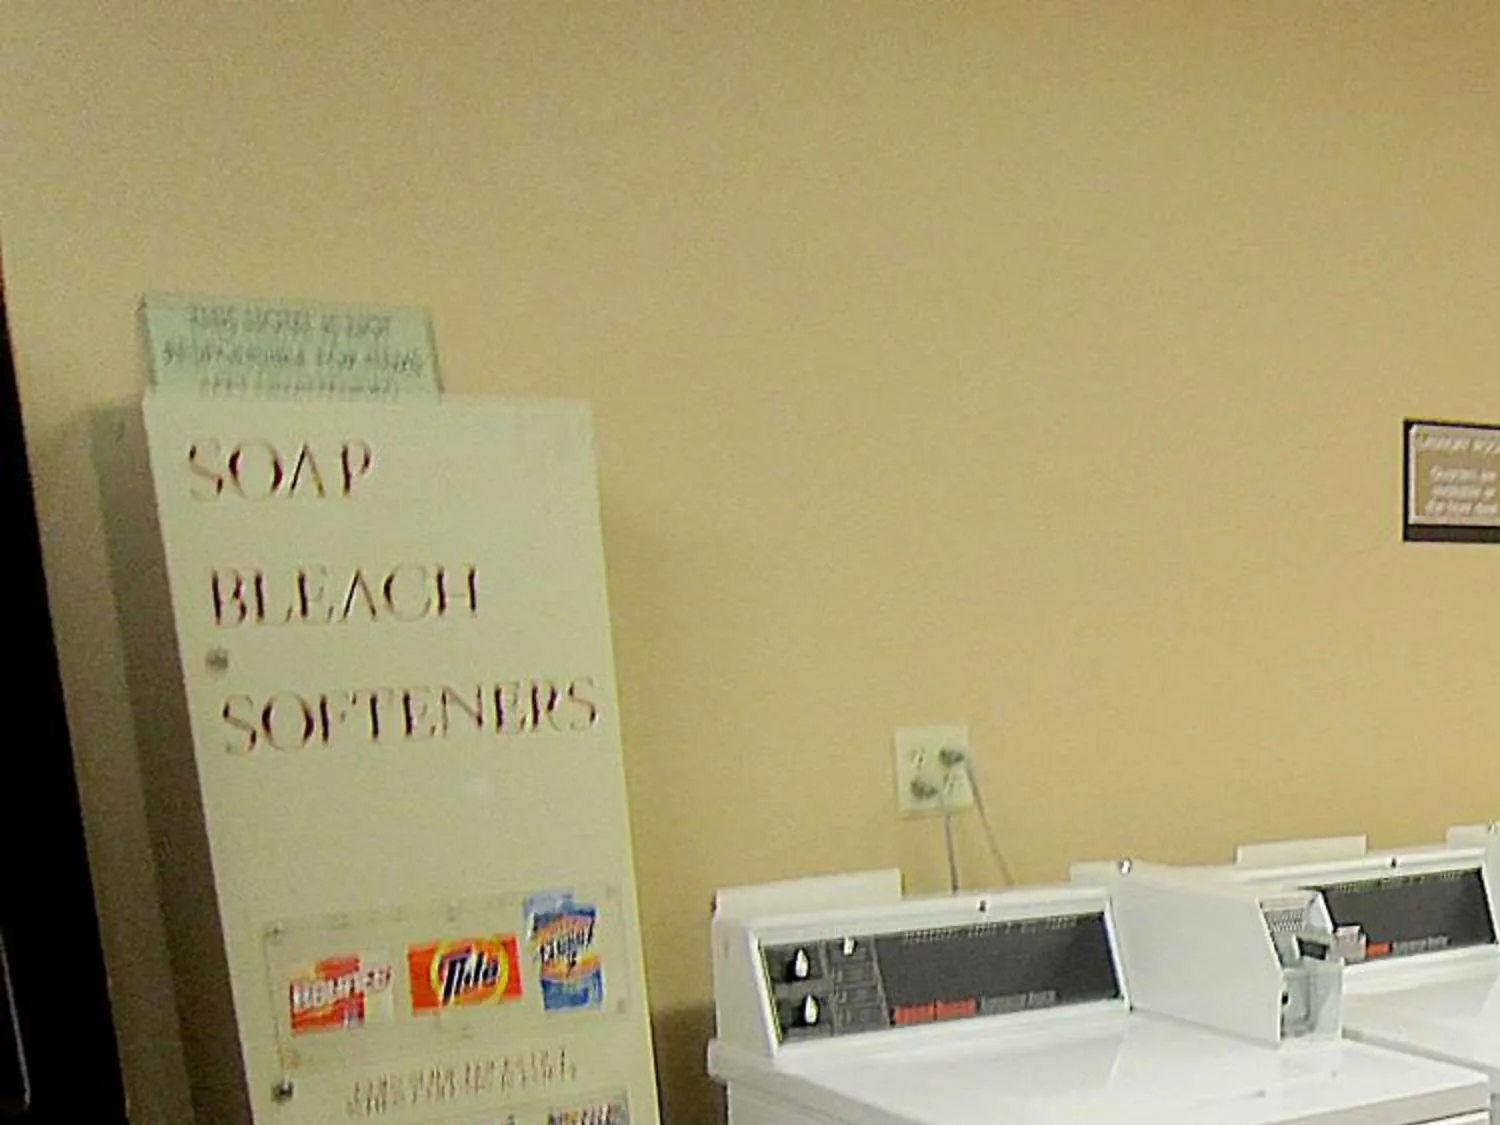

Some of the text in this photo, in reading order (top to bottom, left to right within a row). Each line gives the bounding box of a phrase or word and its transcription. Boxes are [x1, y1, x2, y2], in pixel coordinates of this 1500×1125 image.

[187, 436, 373, 503] SOAP
[209, 561, 480, 629] BLEACH
[221, 676, 599, 757] SOFTENERS
